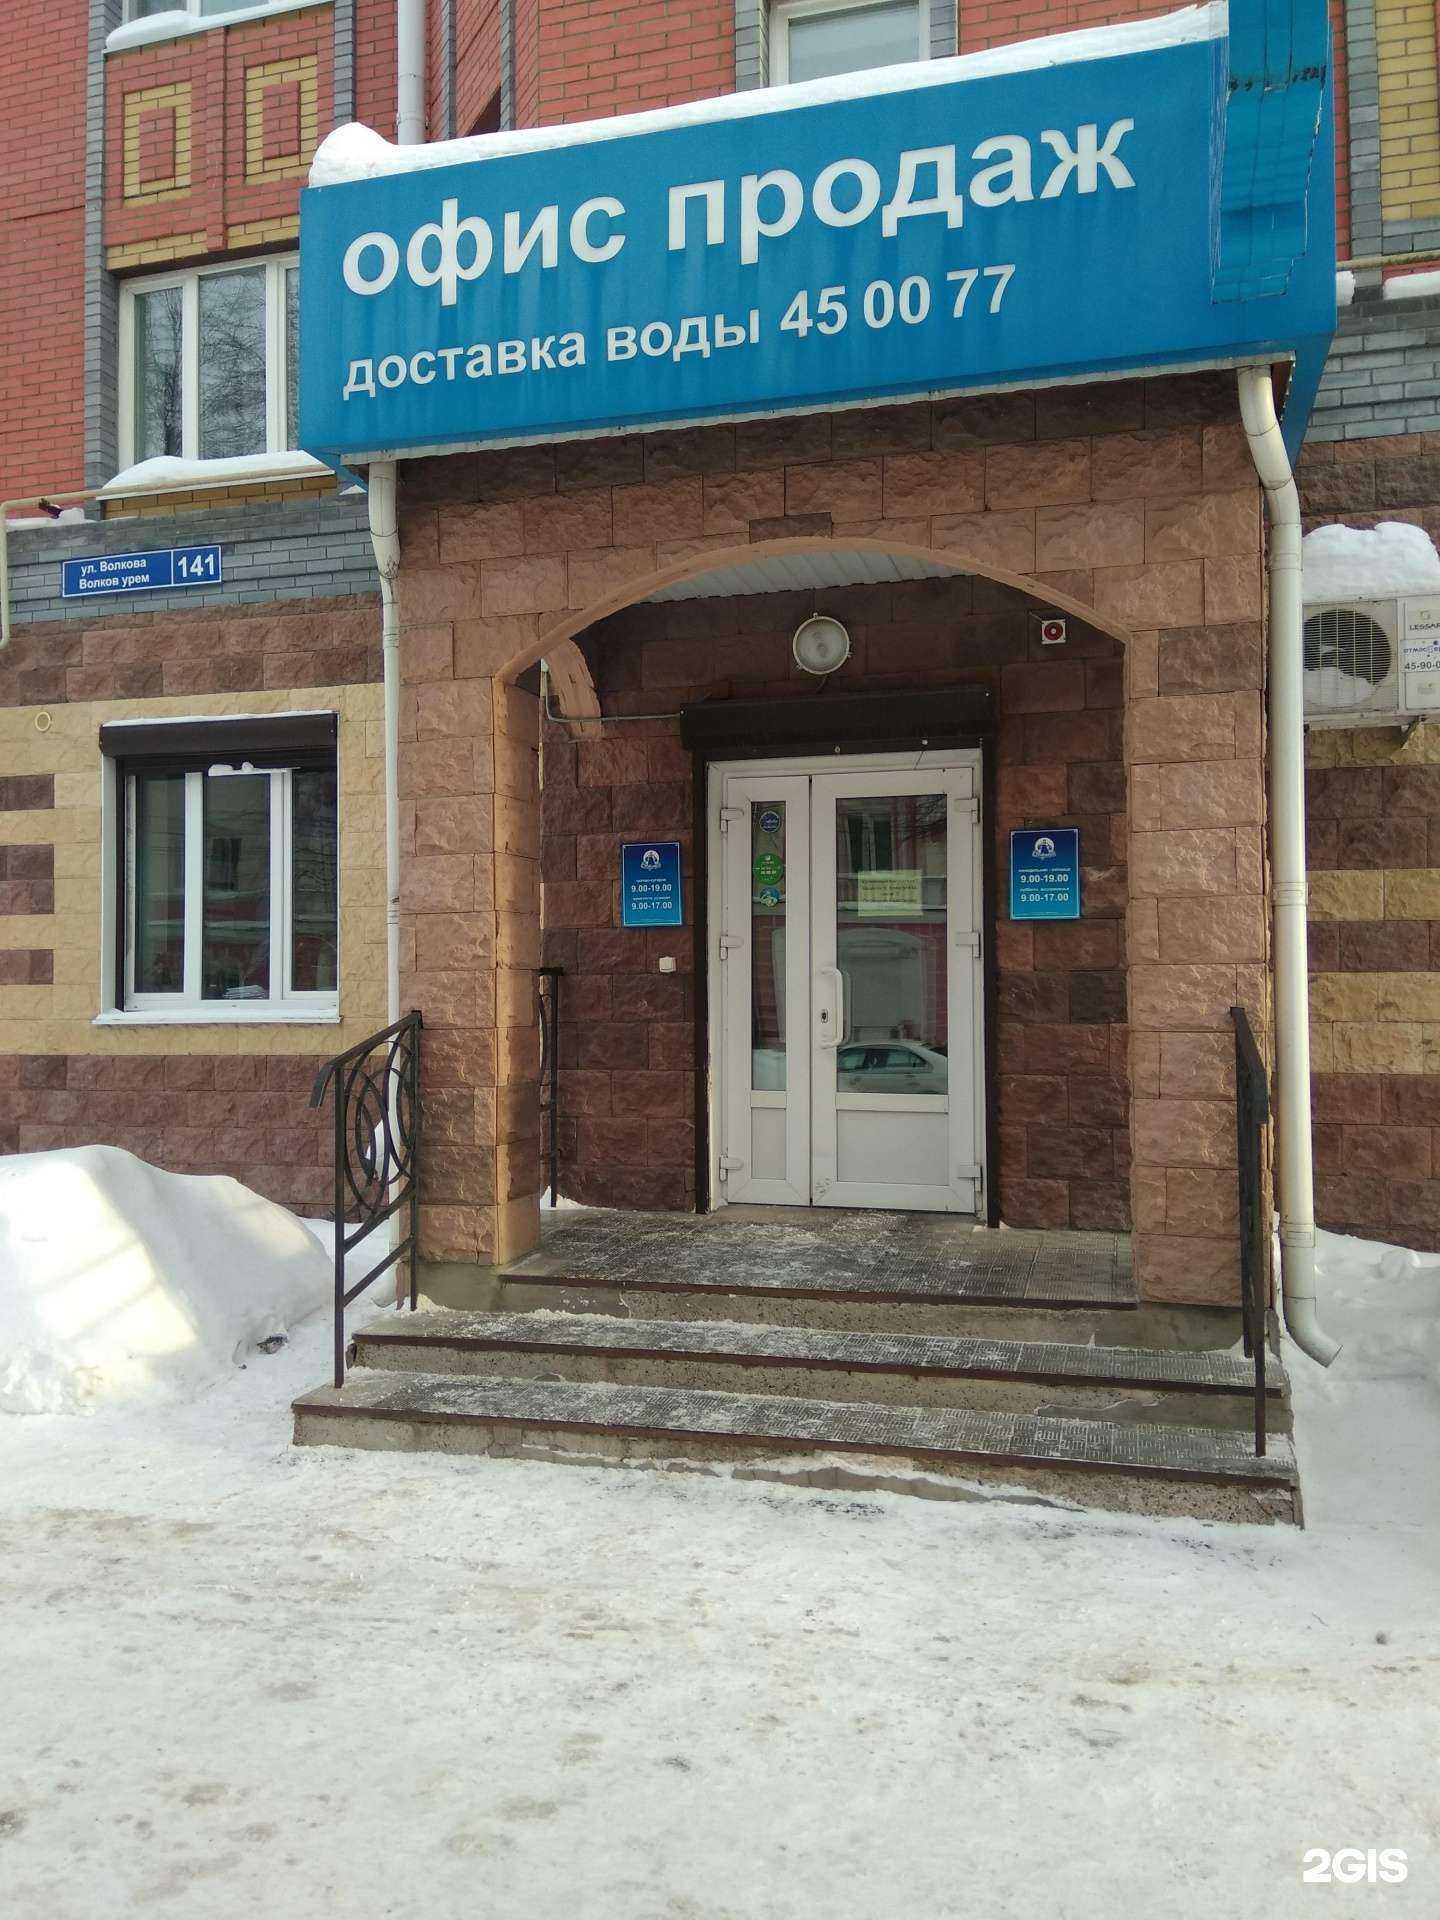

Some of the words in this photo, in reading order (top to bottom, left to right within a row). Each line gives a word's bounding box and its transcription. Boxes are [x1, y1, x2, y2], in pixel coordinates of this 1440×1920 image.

[343, 199, 625, 305] офис
[669, 119, 1134, 264] продаж
[344, 333, 585, 400] доставка
[608, 310, 758, 361] воды
[781, 287, 847, 337] 45
[864, 276, 930, 328] 00
[947, 265, 1015, 318] 77
[80, 563, 97, 576] ул.
[101, 558, 147, 572] Волкова
[177, 554, 215, 578] 141
[80, 577, 119, 590] Волков
[121, 574, 149, 588] урем
